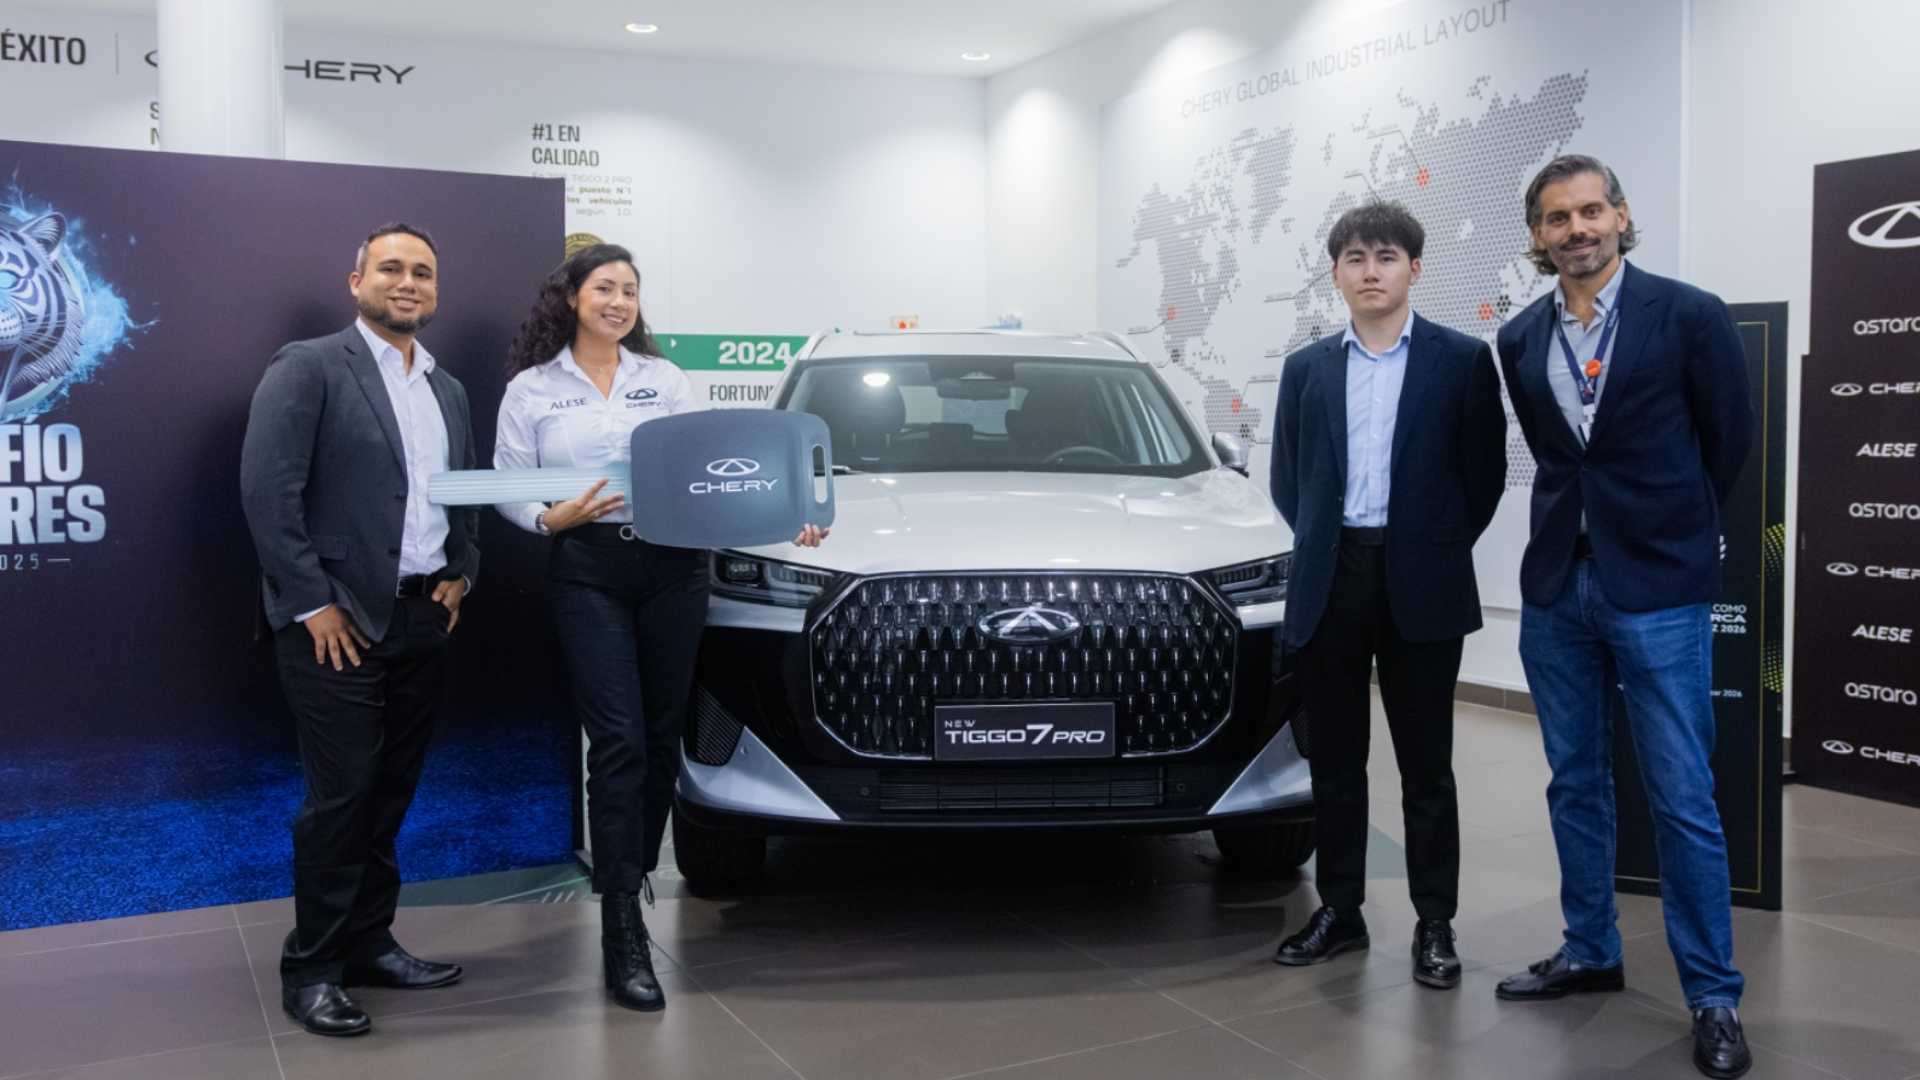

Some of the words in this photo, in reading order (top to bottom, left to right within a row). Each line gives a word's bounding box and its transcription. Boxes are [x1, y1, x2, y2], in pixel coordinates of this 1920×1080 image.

[0, 28, 87, 66] ÉXITO
[1181, 86, 1233, 119] CHERY
[1236, 67, 1300, 102] GLOBAL
[1306, 30, 1417, 80] INDUSTRIAL
[1424, 0, 1510, 46] LAYOUT
[532, 123, 554, 141] #1
[558, 125, 581, 142] EN
[531, 147, 600, 167] CALIDAD
[718, 341, 792, 365] 2024
[709, 384, 775, 402] FORTUN
[550, 397, 587, 411] ALESE
[1856, 443, 1918, 458] ALESE
[689, 478, 779, 495] CHERY
[0, 484, 107, 545] RES
[1849, 502, 1920, 520] astara
[1712, 603, 1747, 614] COMO
[1720, 624, 1747, 634] 2026
[1852, 624, 1913, 642] ALESE
[1844, 682, 1918, 706] astara
[944, 719, 976, 728] NEW
